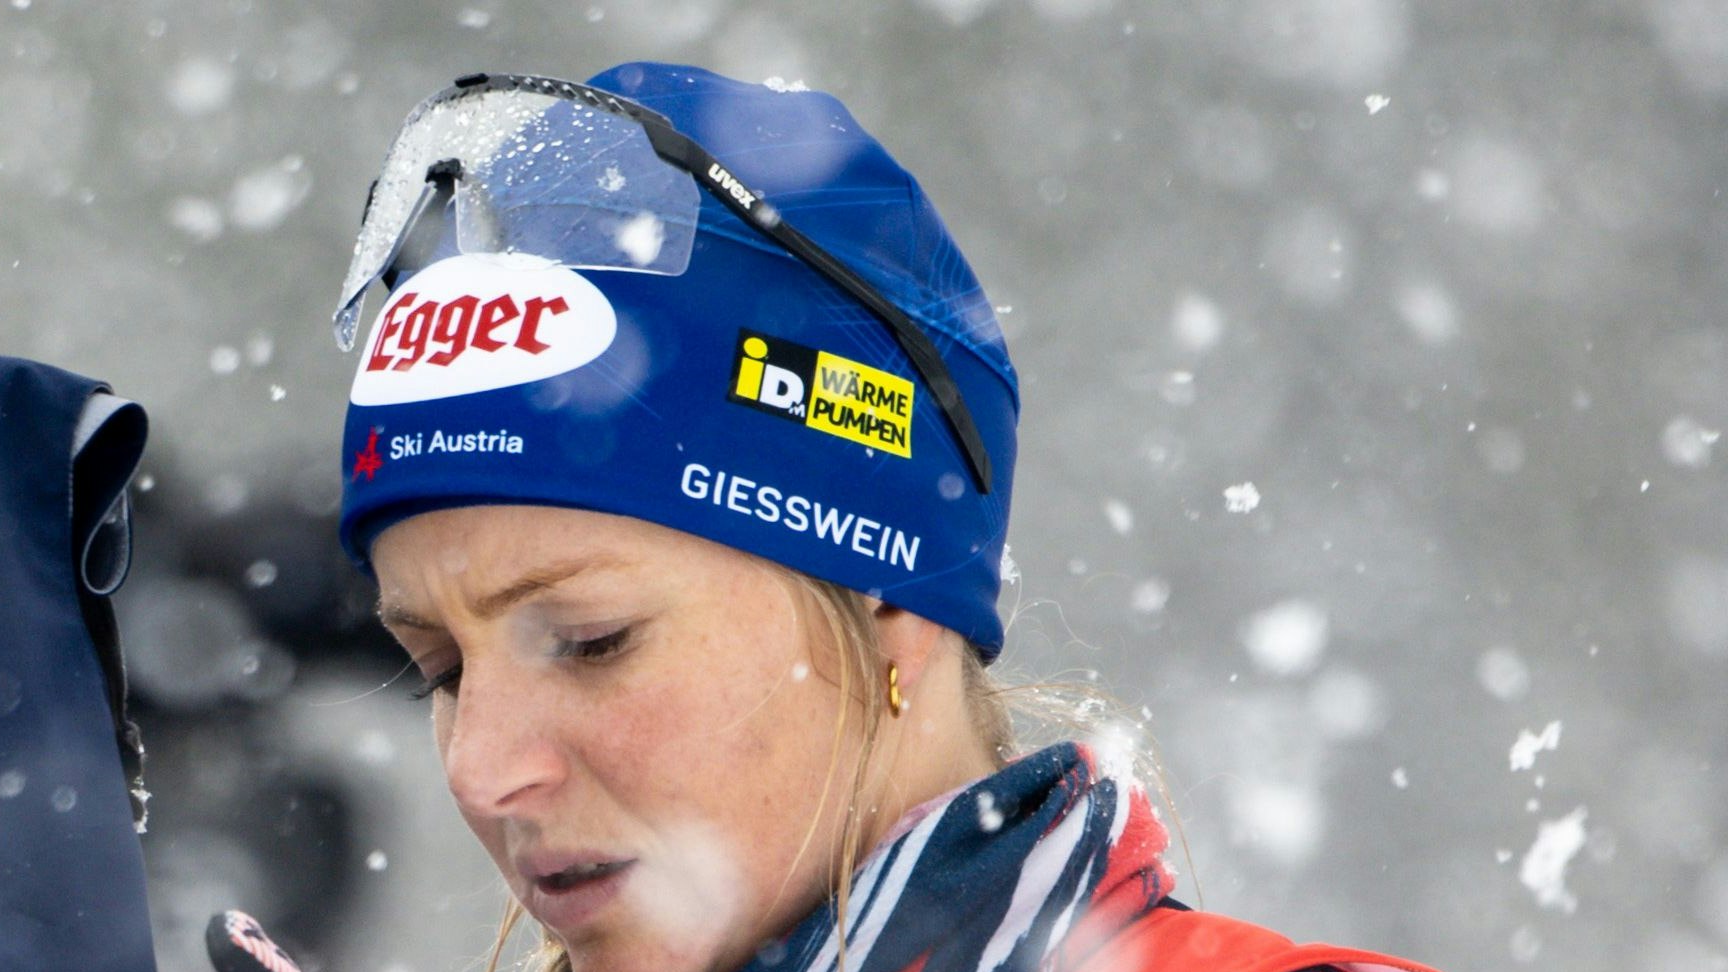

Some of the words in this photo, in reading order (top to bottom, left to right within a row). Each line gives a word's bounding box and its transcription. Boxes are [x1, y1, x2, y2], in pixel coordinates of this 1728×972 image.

[706, 161, 756, 210] uvex
[365, 291, 570, 373] Egger
[820, 365, 909, 418] WÄRME
[389, 432, 424, 460] Ski
[428, 429, 524, 456] Austria
[812, 396, 906, 449] PUMPEN
[680, 462, 921, 572] GIESSWEIN
